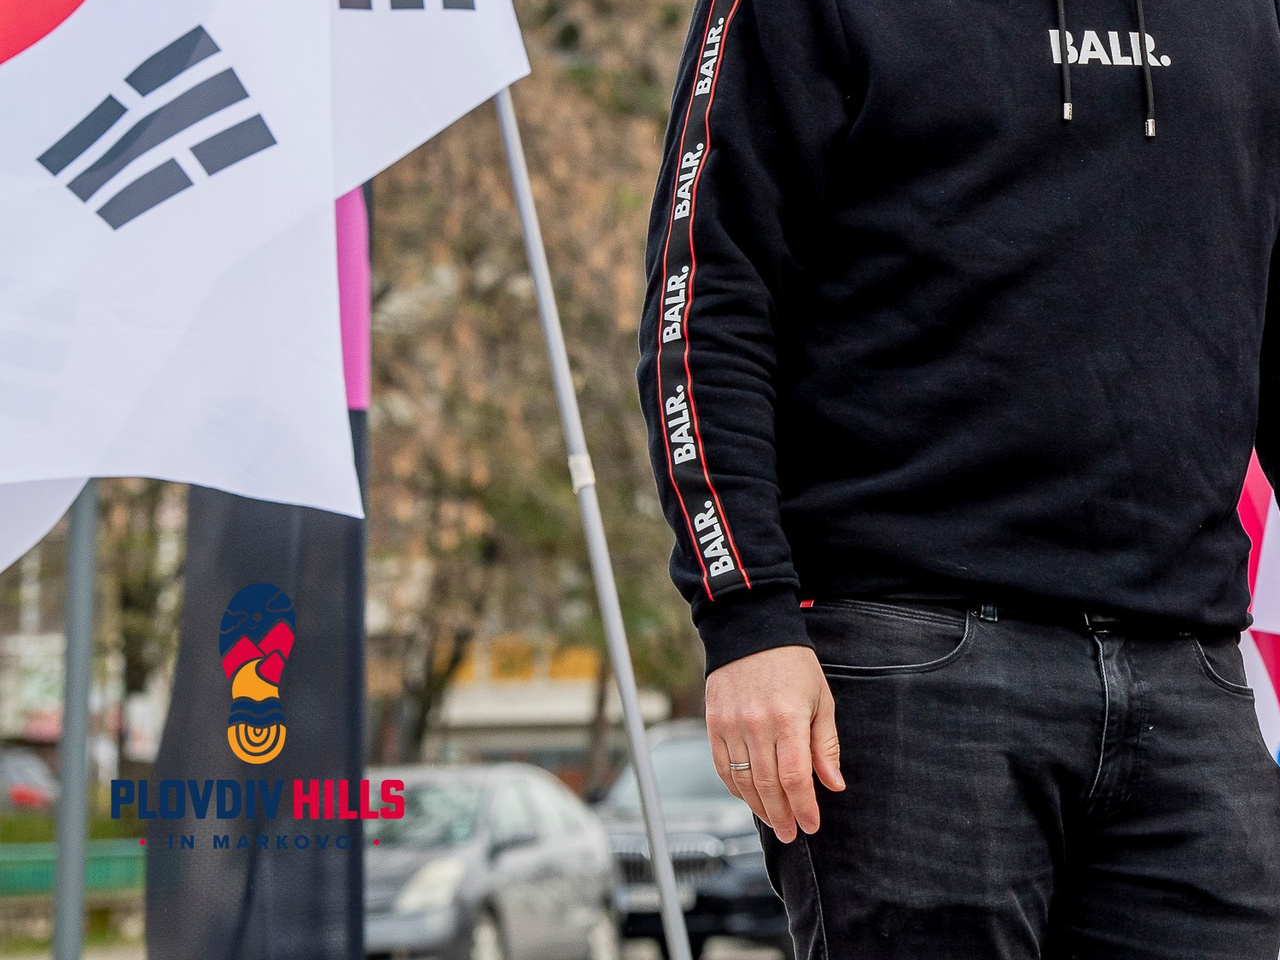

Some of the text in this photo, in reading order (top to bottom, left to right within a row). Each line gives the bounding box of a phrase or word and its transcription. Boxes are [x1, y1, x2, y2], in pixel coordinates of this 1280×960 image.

[694, 17, 725, 97] BALR.
[1048, 29, 1172, 67] BALR.
[673, 142, 704, 221] BALR.
[662, 265, 690, 344] BALR.
[665, 384, 697, 465] BALR.
[694, 500, 736, 578] BALR.
